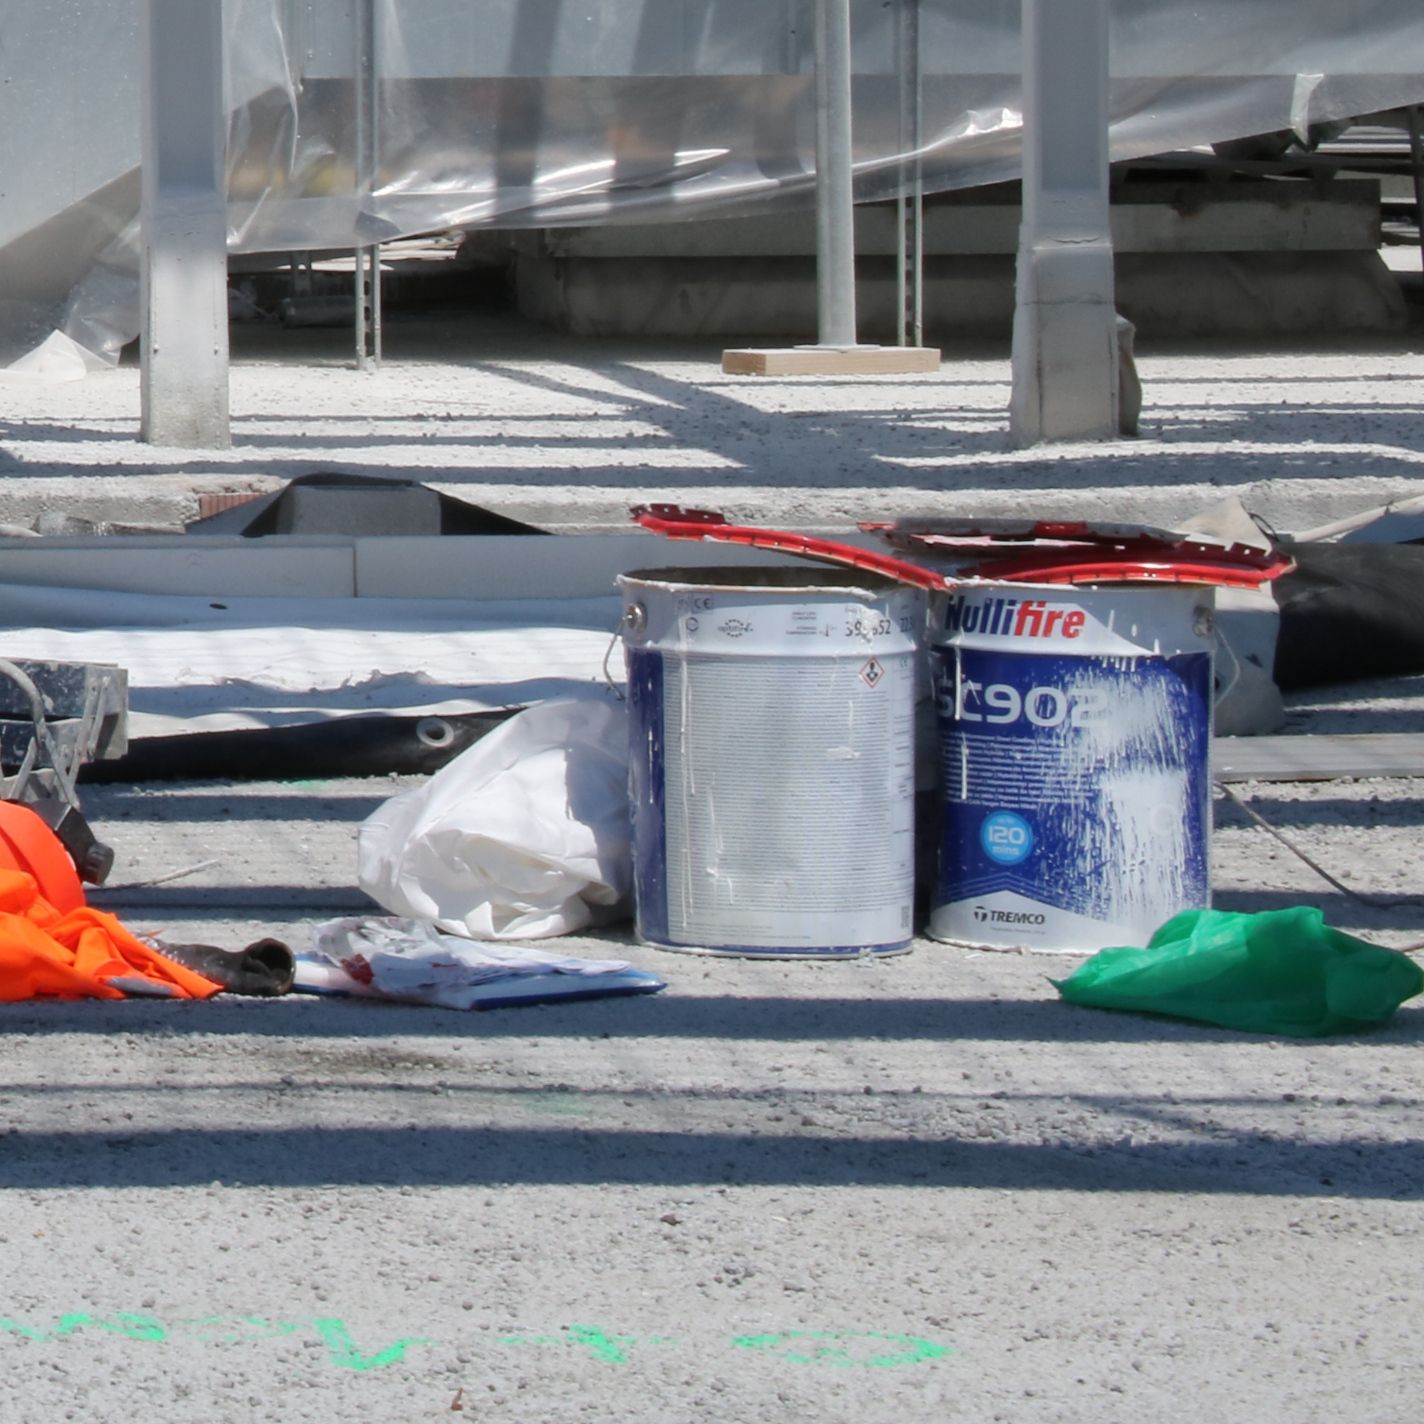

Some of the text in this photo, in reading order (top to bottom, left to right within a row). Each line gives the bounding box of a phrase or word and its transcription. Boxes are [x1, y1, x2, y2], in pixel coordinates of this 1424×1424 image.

[944, 595, 1086, 639] Nullifire
[988, 825, 1025, 845] 120
[990, 909, 1046, 925] TREMCO
